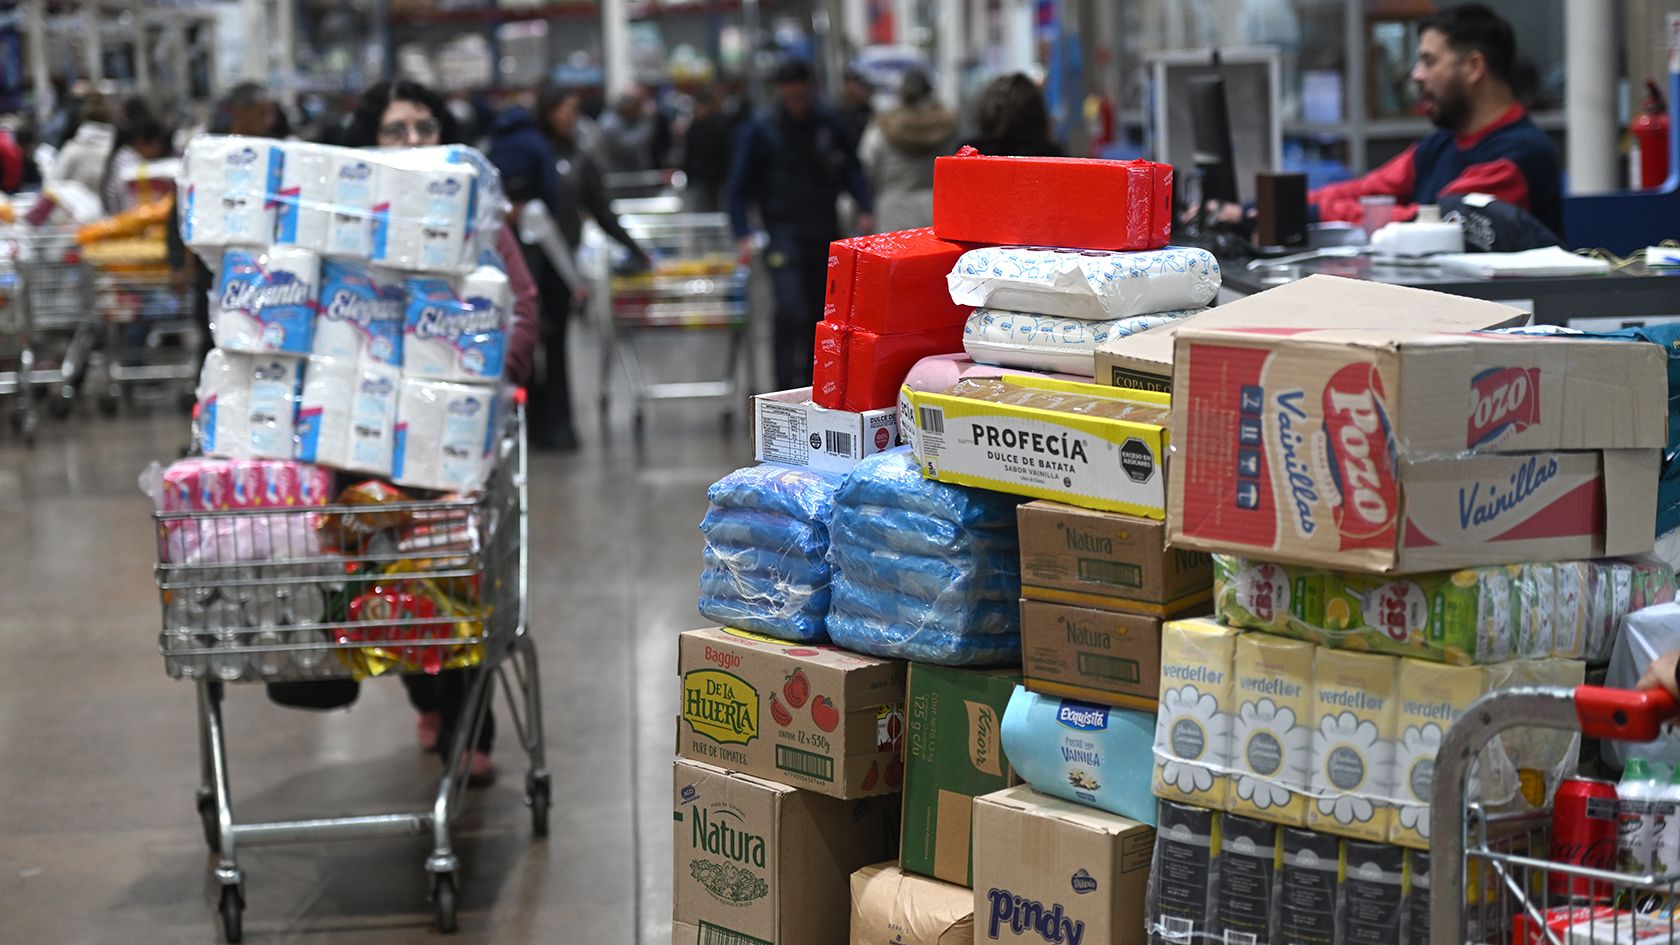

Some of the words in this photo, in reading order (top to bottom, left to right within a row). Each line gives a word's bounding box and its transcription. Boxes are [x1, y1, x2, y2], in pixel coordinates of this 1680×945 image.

[1116, 376, 1144, 391] COPA
[1147, 382, 1162, 392] DE
[971, 423, 1088, 464] PROFECÍA
[987, 451, 1019, 464] DULCE
[1022, 457, 1035, 467] DE
[1039, 459, 1076, 473] BATATA
[1004, 464, 1027, 474] SABOR
[1029, 469, 1060, 480] VAINILLA
[1276, 390, 1318, 535] Vainillas
[1458, 456, 1559, 530] Vainillas
[1066, 527, 1113, 554] Natura
[1066, 620, 1111, 649] Natura
[705, 646, 741, 669] Baggio
[1162, 664, 1224, 684] verdeflor
[1240, 676, 1303, 698] verdeflor
[685, 688, 754, 735] HUERTA
[914, 695, 926, 717] 125
[976, 707, 992, 767] Knorr
[709, 745, 719, 758] DE
[1061, 746, 1100, 767] VAINILLA
[691, 804, 766, 869] Natura
